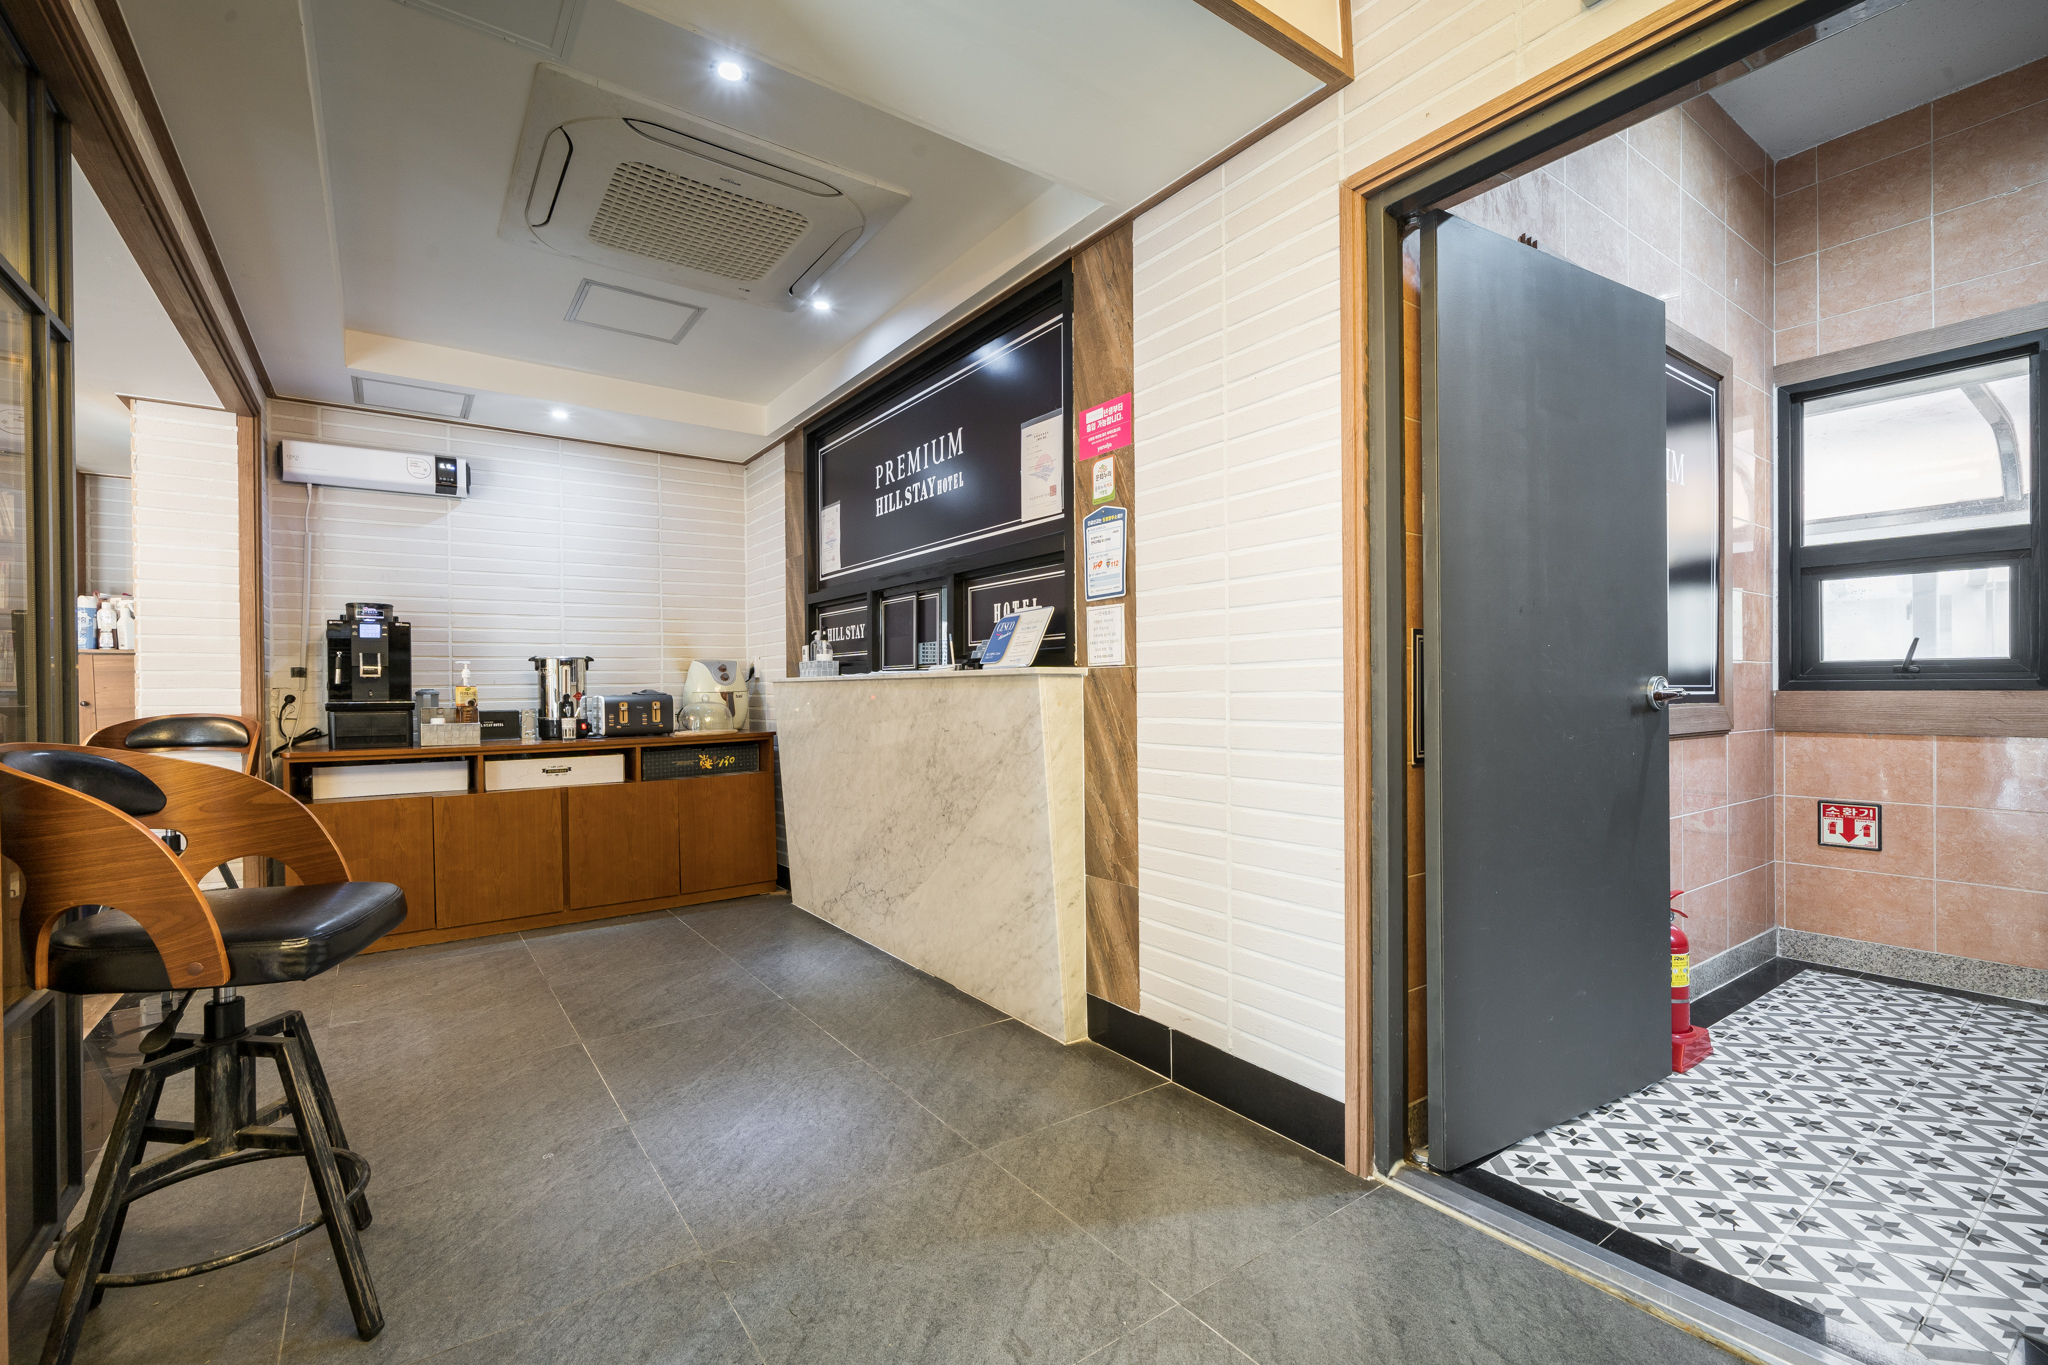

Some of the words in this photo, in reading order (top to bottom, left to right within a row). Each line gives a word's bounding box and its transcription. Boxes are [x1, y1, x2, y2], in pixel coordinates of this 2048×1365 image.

[875, 427, 964, 489] PREMIUM
[875, 489, 903, 517] HILL
[904, 475, 936, 507] STAY
[937, 471, 964, 496] HOTEL
[1110, 559, 1120, 567] 112
[827, 626, 844, 642] HILL
[845, 623, 866, 640] STAY
[1825, 806, 1874, 818] 소화기
